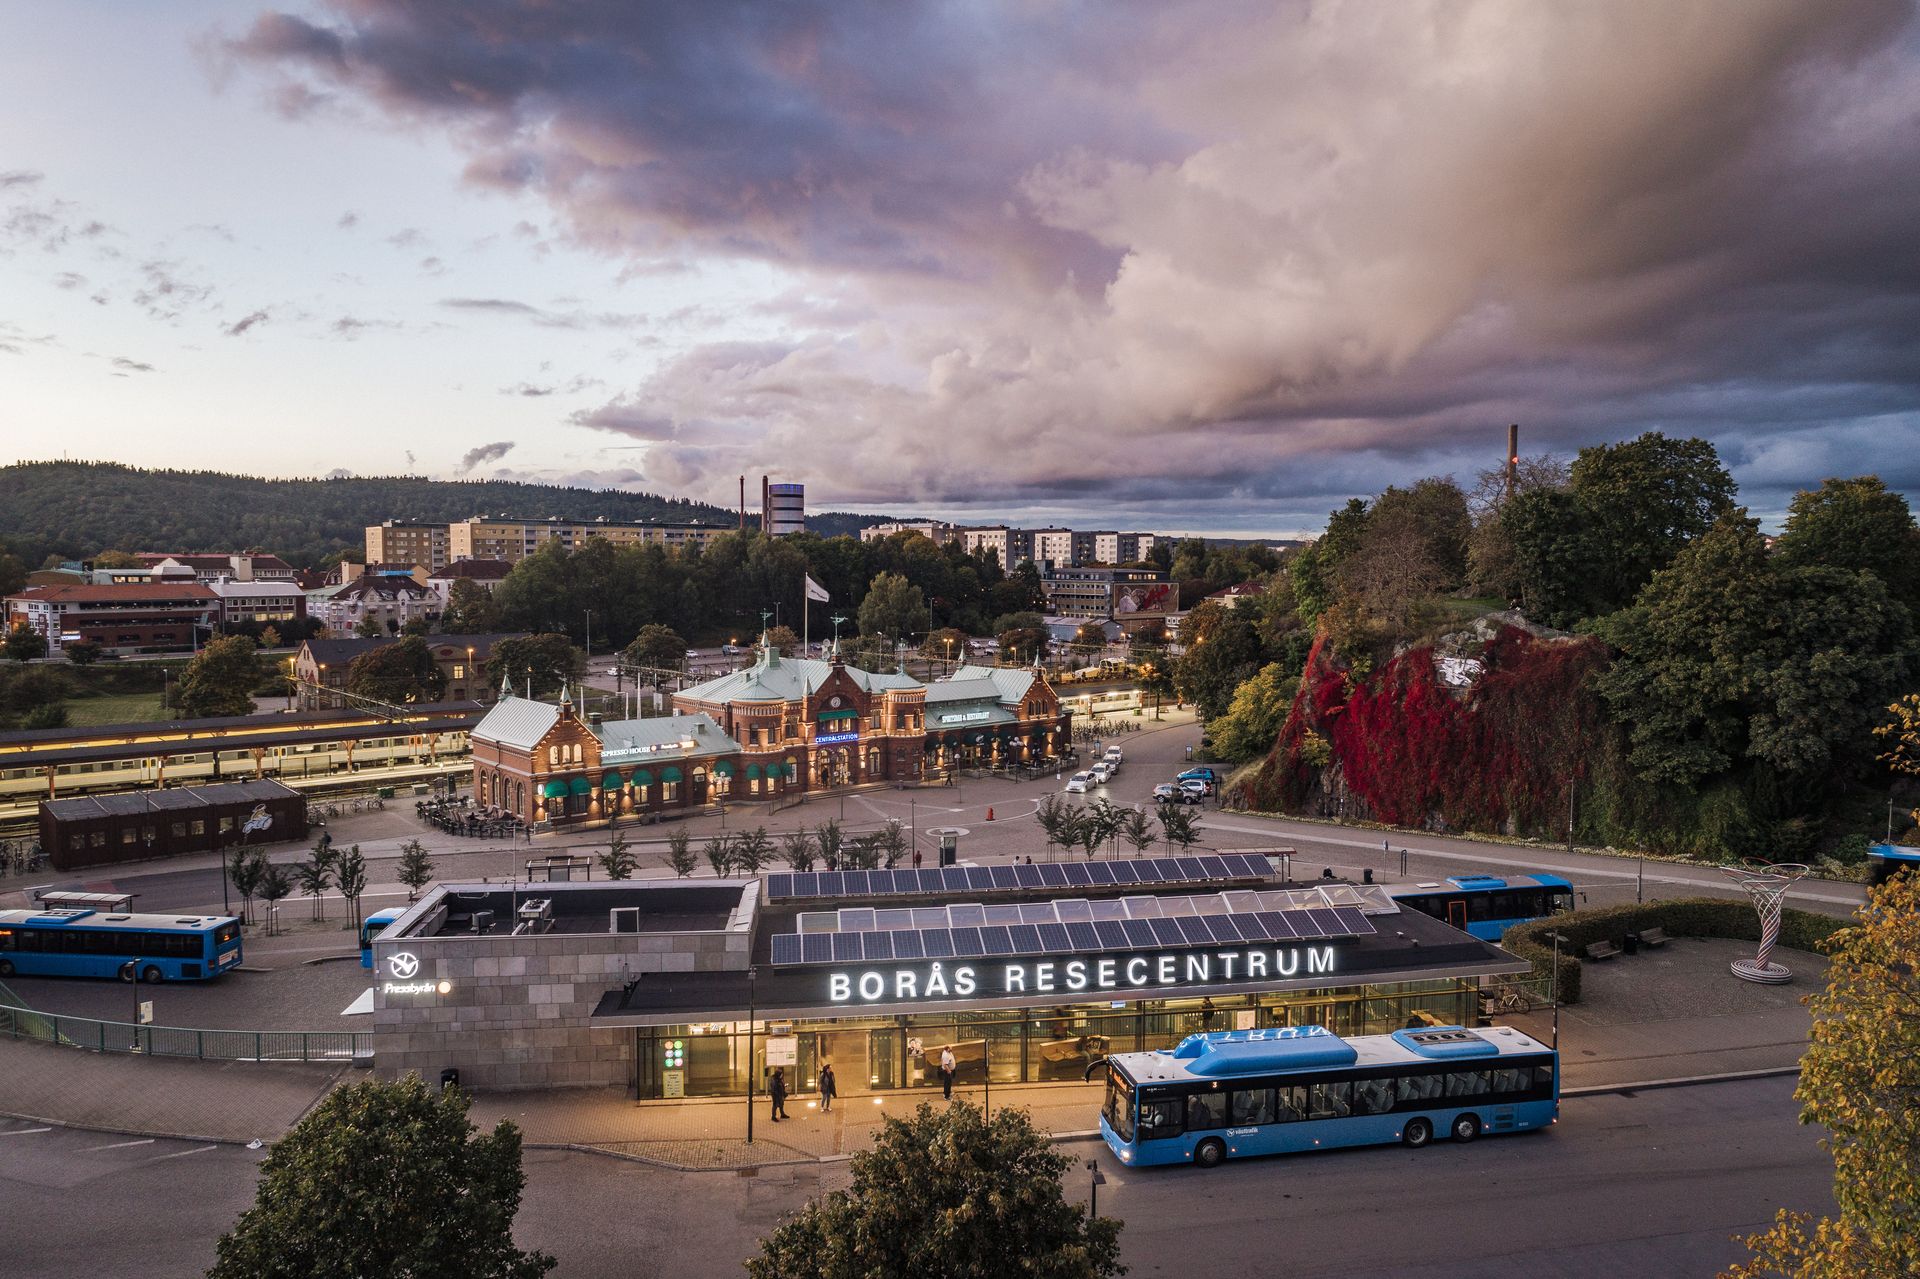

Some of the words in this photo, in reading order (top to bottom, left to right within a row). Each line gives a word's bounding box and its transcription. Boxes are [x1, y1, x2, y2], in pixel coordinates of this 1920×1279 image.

[815, 733, 858, 743] CENTRALSTATION
[629, 745, 651, 755] HOUSE
[830, 961, 976, 1001] BORÅS
[1005, 946, 1334, 992] RESECENTRUM
[385, 982, 436, 995] Pressbyrån
